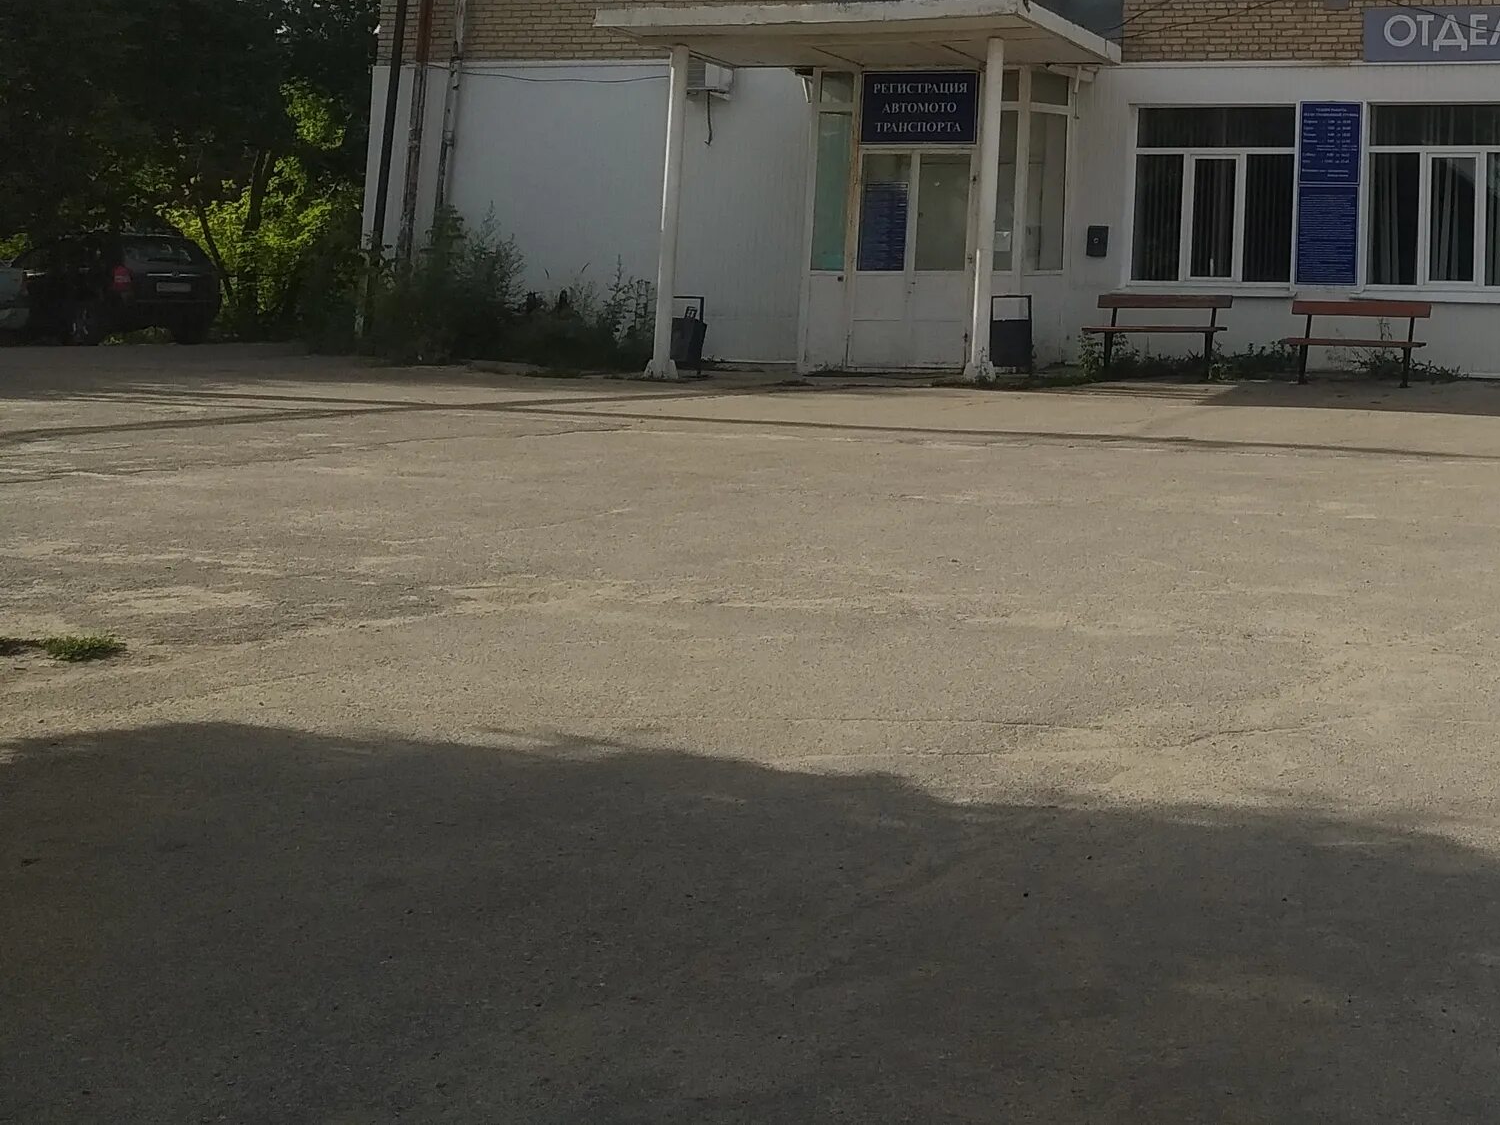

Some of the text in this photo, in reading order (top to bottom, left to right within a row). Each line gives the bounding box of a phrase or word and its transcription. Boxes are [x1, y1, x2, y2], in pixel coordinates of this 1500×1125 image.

[873, 82, 968, 95] РЕГИСТРАЦИЯ
[882, 102, 957, 114] АВТОМОТО
[875, 121, 962, 133] ТРАНСПОРТА
